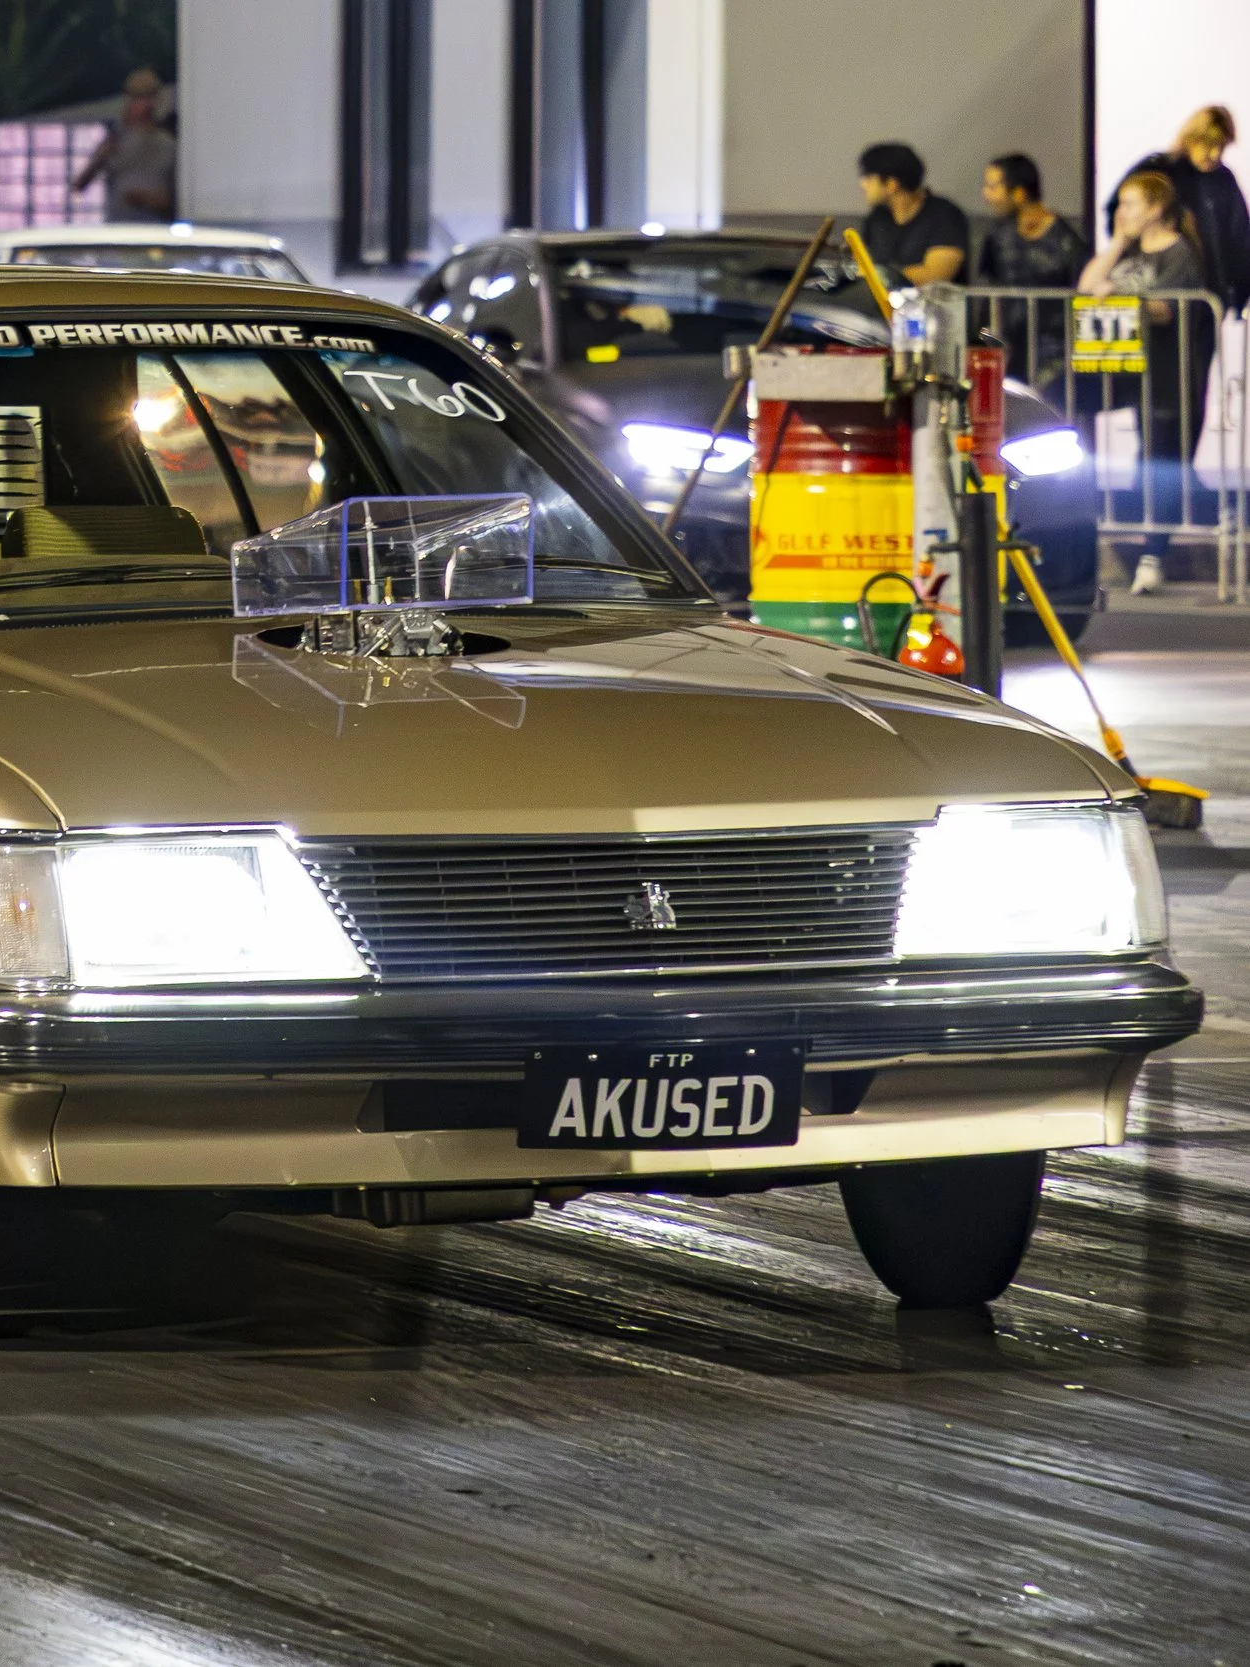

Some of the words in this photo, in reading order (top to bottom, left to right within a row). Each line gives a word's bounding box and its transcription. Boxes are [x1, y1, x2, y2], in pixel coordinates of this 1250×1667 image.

[28, 323, 375, 352] PERFORMANCE.com
[649, 1053, 694, 1069] FTP
[548, 1074, 775, 1138] AKUSED
